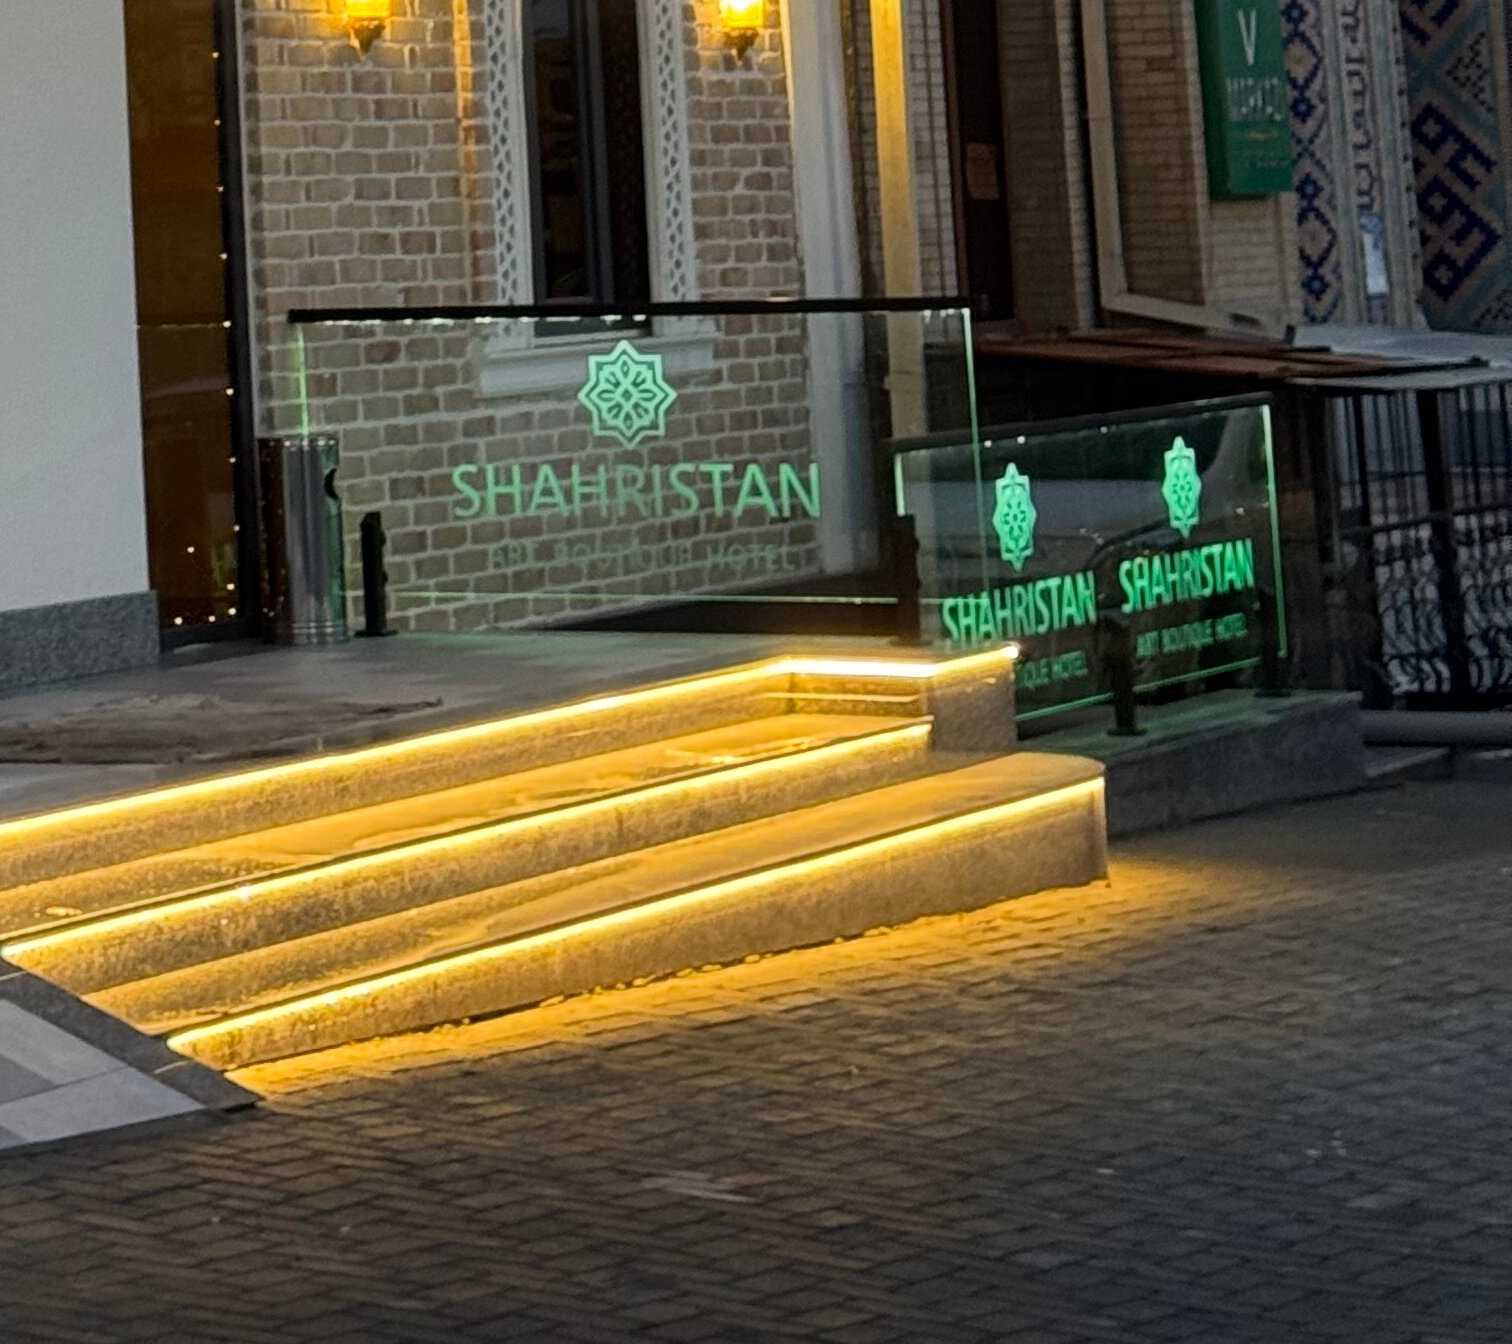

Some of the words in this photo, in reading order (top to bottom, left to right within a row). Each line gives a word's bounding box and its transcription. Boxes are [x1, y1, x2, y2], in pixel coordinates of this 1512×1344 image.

[451, 461, 822, 519] SHAHRISTAN
[707, 543, 795, 571] HOTEL
[1118, 537, 1256, 615] SHAHRISTAN
[942, 569, 1097, 646] SHAHRISTAN
